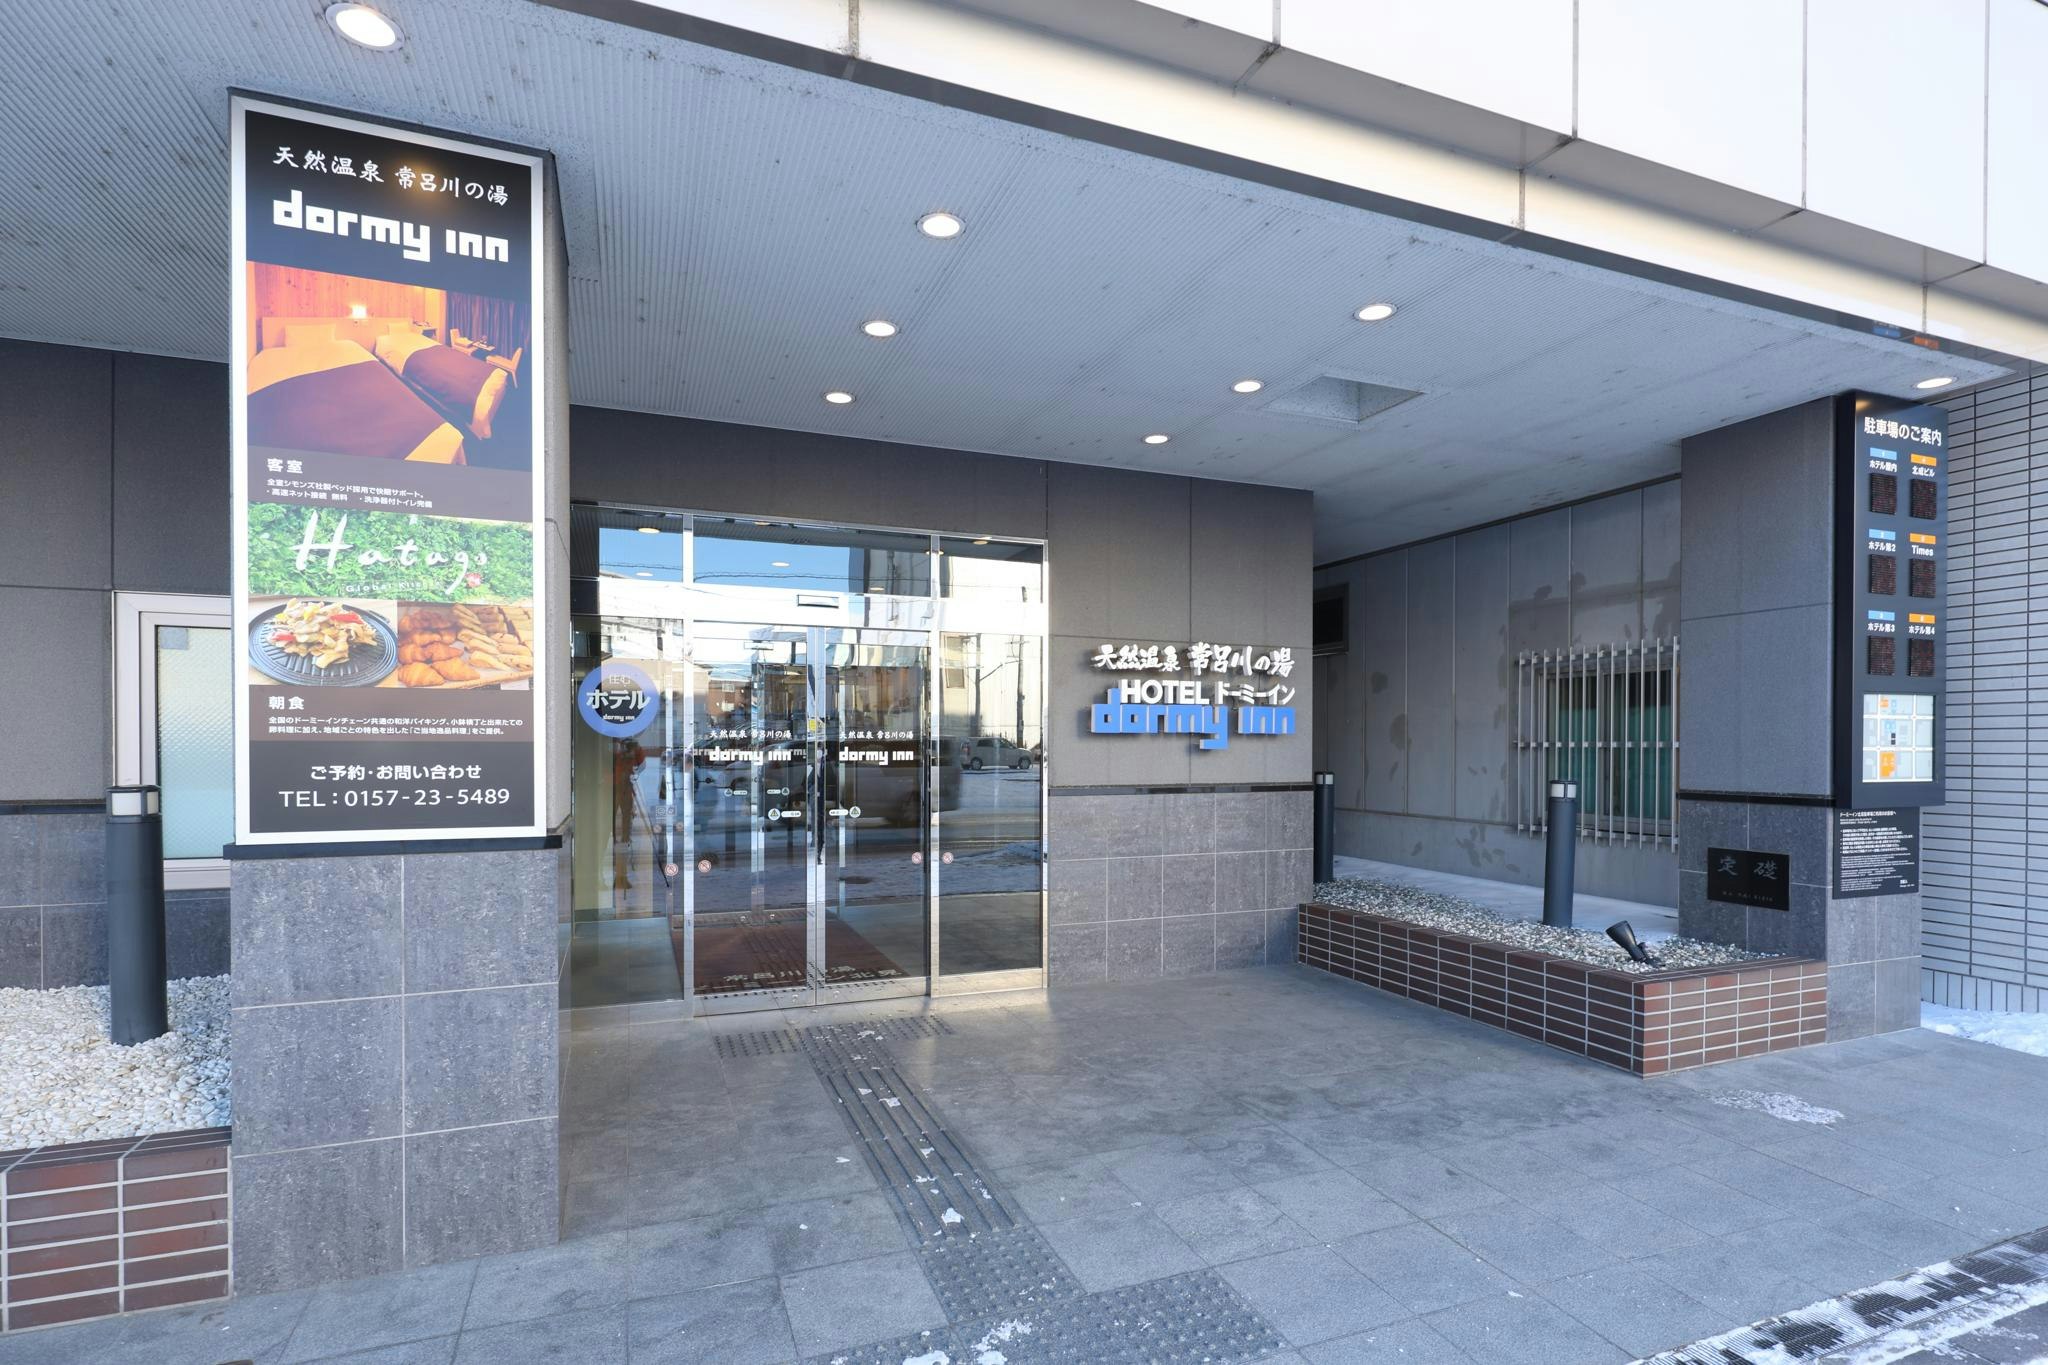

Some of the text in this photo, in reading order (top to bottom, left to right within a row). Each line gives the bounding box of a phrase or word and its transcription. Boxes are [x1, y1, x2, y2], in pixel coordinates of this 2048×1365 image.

[273, 146, 509, 206] 天然温泉 常呂川の湯
[273, 189, 509, 262] dormy inn
[1864, 417, 1942, 446] 駐車場のご案内
[267, 458, 303, 474] 客室
[1912, 545, 1934, 556] Times
[1091, 641, 1295, 678] 天然温泉 常呂川の湯
[586, 690, 651, 710] ホテル
[1118, 679, 1295, 705] HOTEL ドーミーイン
[268, 696, 305, 710] 朝食
[603, 713, 625, 723] dormy
[1091, 688, 1296, 750] dormy inn
[709, 729, 748, 738] 天然温泉
[839, 729, 873, 739] 天然温泉
[709, 746, 764, 766] dormy
[768, 750, 791, 761] inn
[839, 747, 914, 765] dormy inn
[310, 764, 482, 781] ご予約・お問い合わせ
[1717, 856, 1777, 880] 定礎
